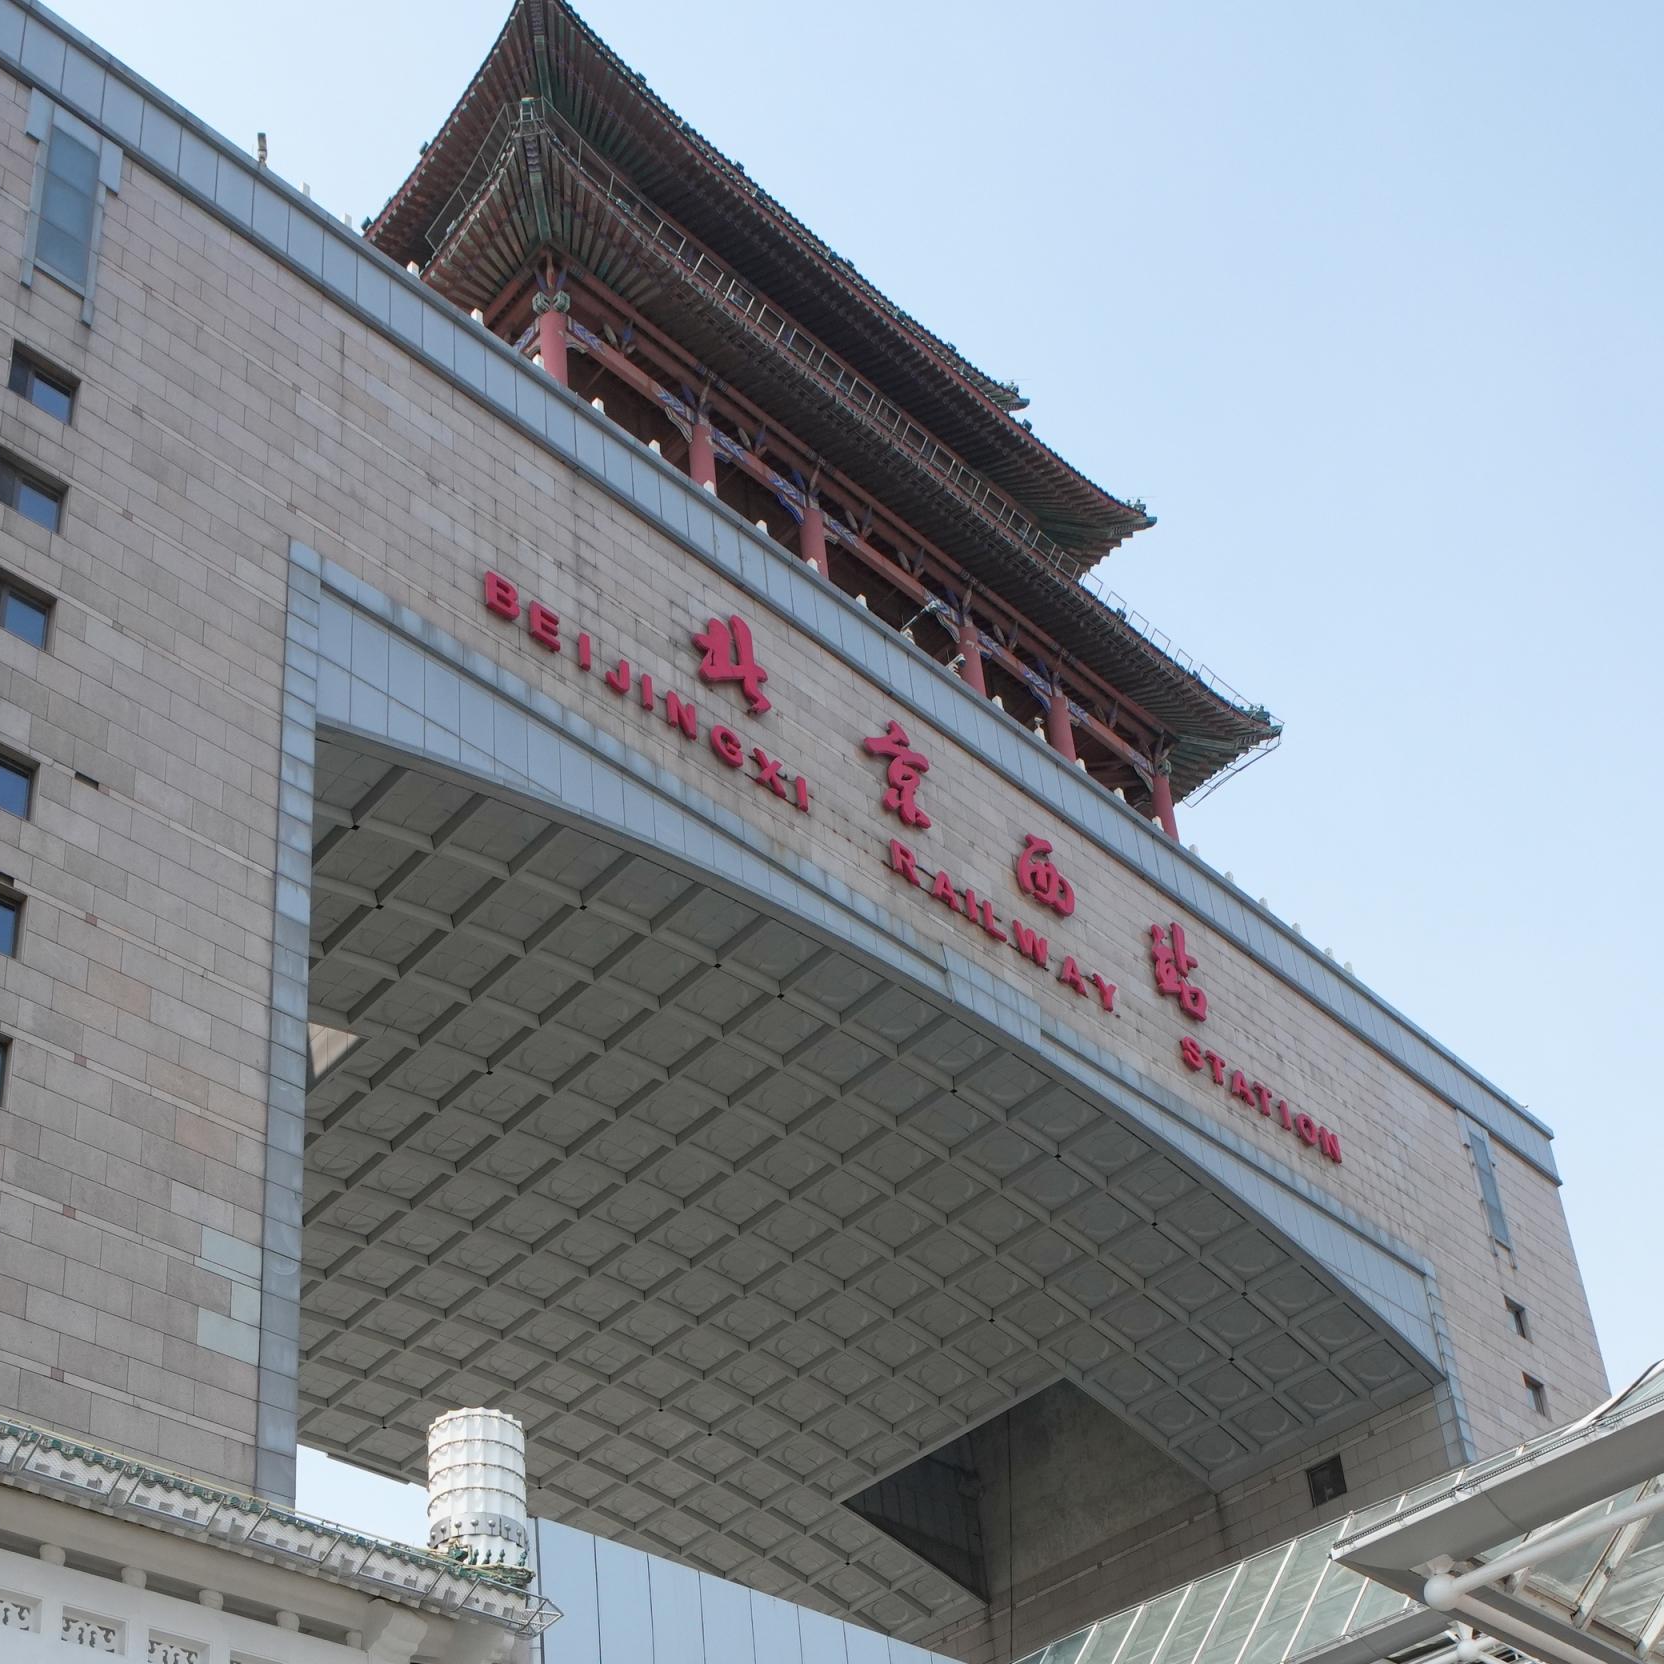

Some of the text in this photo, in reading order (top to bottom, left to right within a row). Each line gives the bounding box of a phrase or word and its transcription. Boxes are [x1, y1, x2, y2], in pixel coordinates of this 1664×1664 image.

[693, 613, 1208, 1022] 北京西站
[890, 838, 1120, 1013] RAILWAY
[1180, 1035, 1343, 1163] STATION
